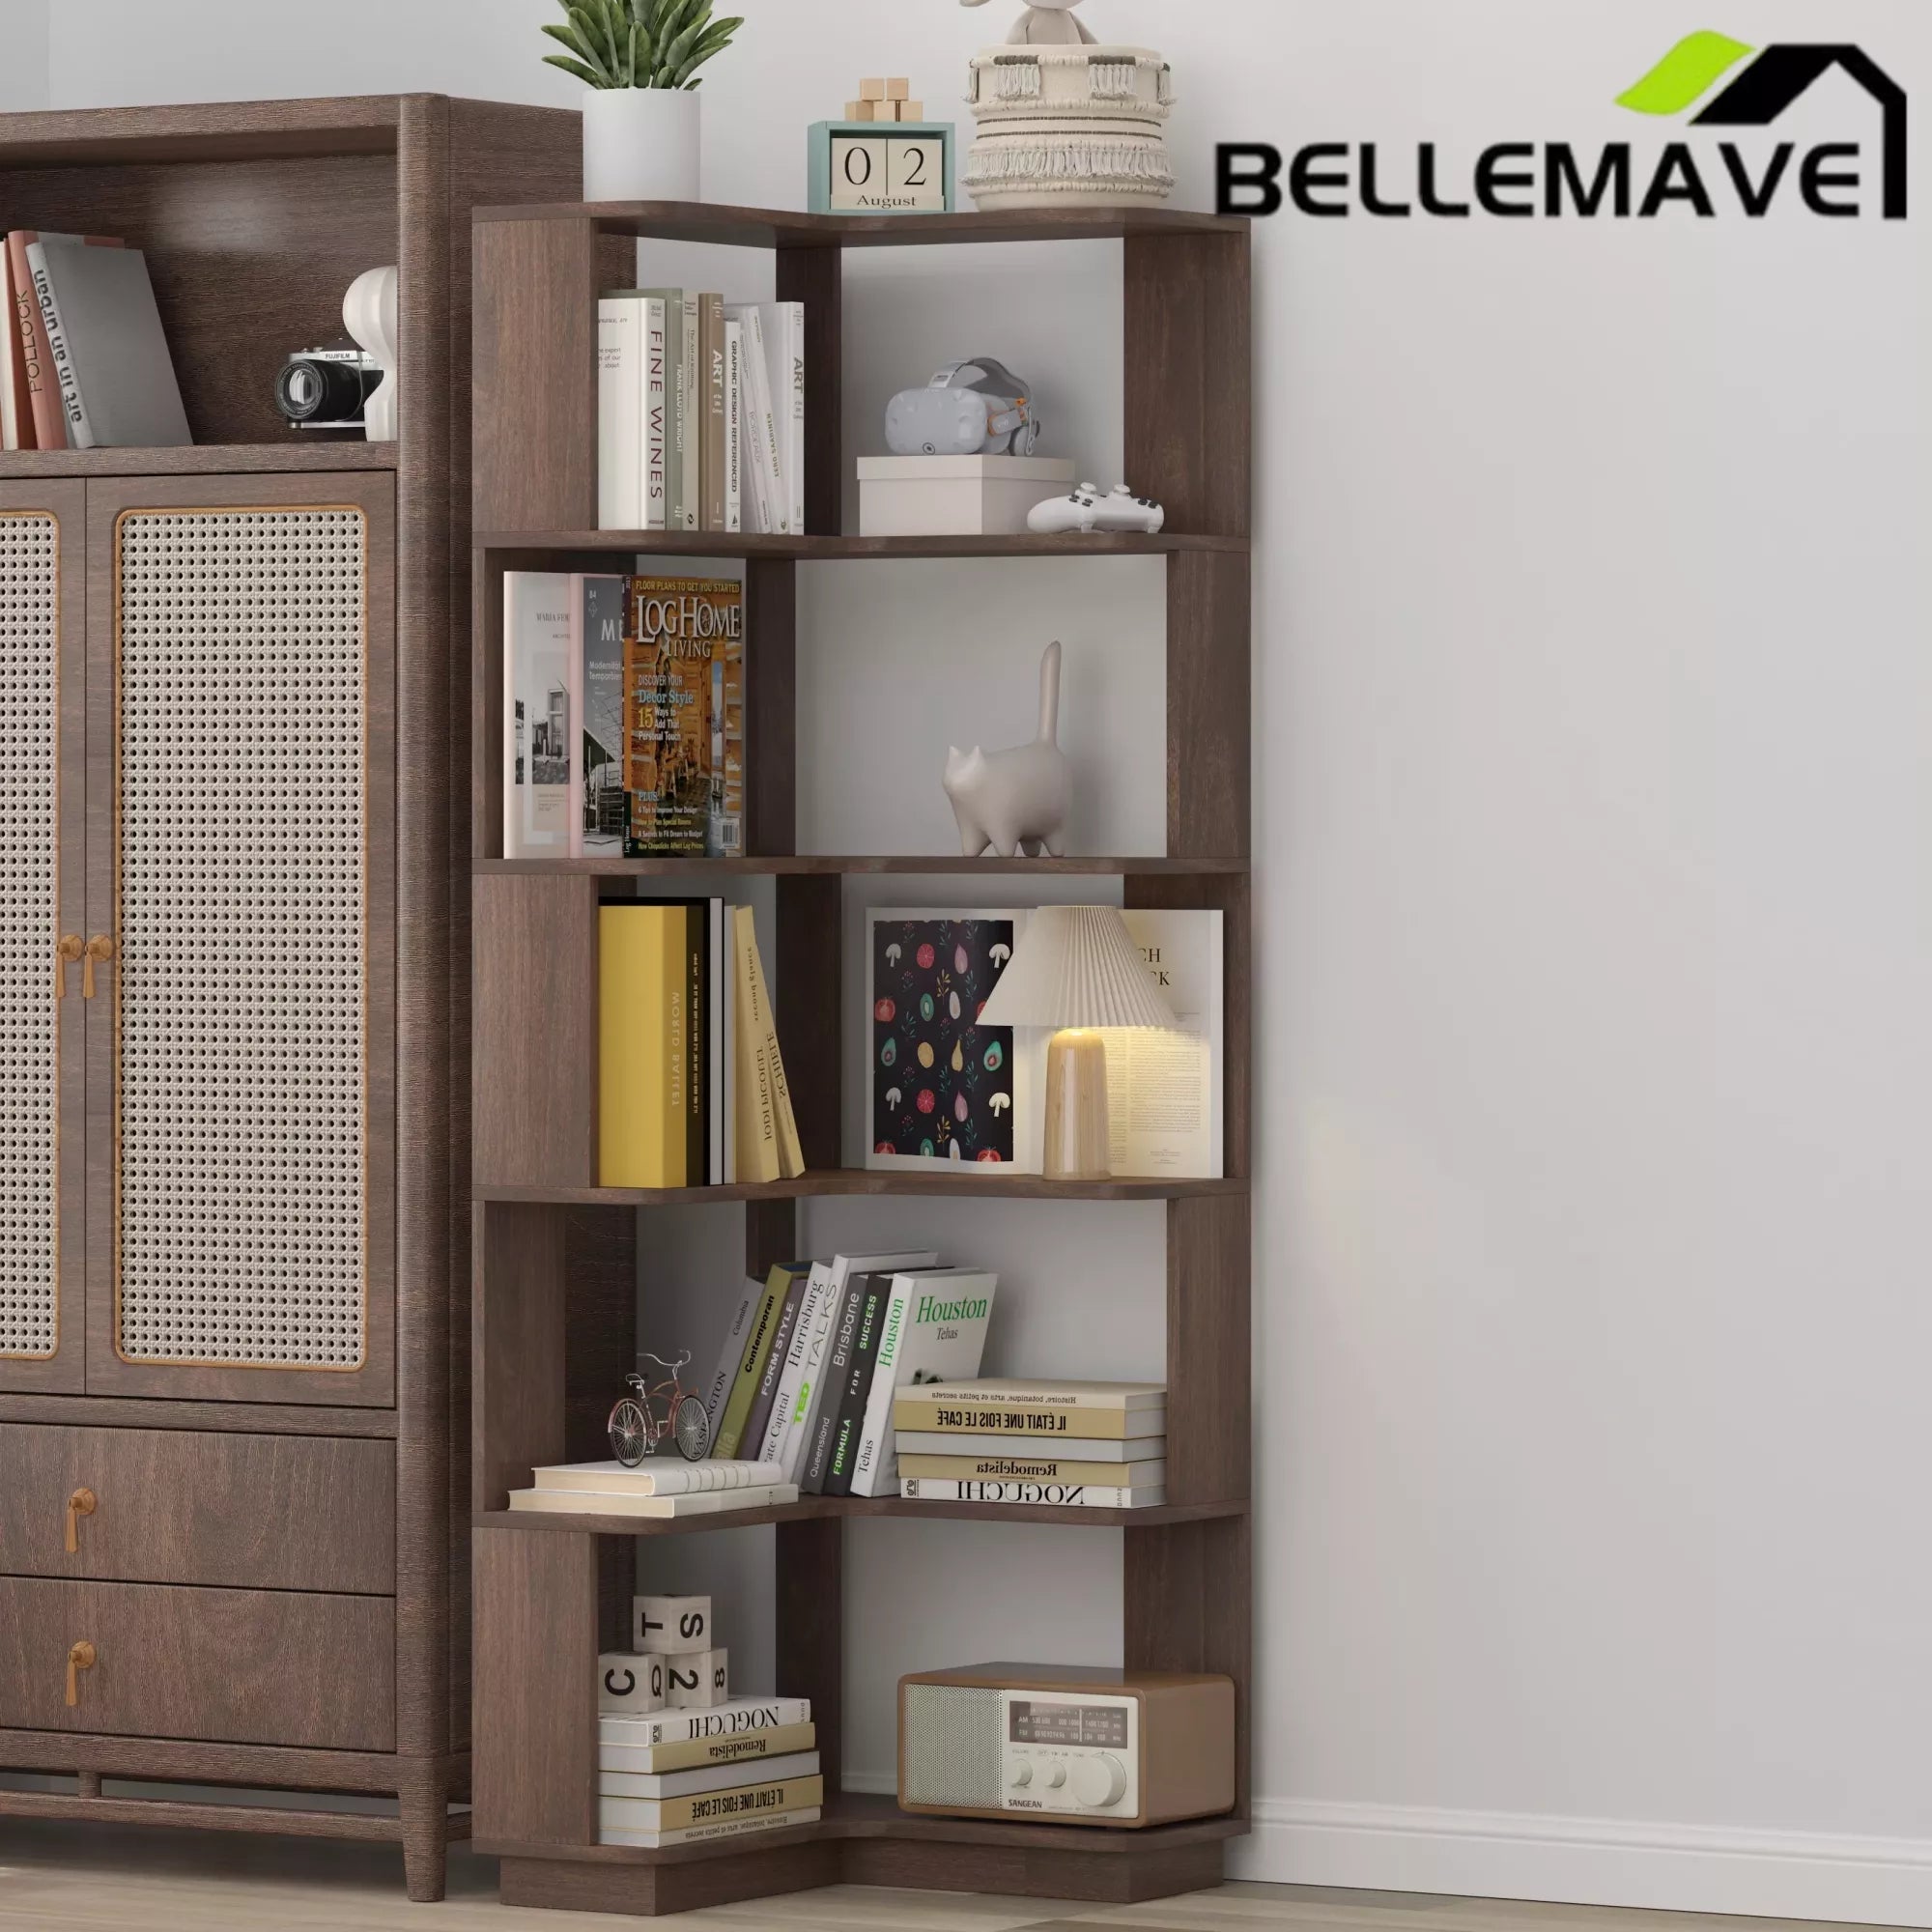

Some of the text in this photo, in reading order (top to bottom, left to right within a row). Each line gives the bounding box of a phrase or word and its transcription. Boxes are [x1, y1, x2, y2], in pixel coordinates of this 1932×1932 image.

[856, 194, 917, 210] August
[16, 290, 43, 393] POLLOCK
[34, 269, 83, 423] art in an urban
[650, 329, 663, 392] FINE
[712, 349, 724, 387] ART
[793, 356, 804, 394] ART
[650, 406, 663, 498] WINES
[636, 580, 740, 593] FLOOR PLANS TO GET YOU STARTED
[667, 639, 711, 658] LIVING
[639, 674, 683, 686] DISCOVER YOUR
[654, 706, 669, 718] Ways
[668, 689, 694, 708] Style
[638, 707, 654, 728] 15
[654, 719, 666, 728] Add
[638, 731, 681, 741] Personal Touch
[787, 1280, 824, 1369] Harrisburg
[917, 1295, 988, 1323] Houston
[745, 1294, 775, 1374] Contemporan
[833, 1292, 861, 1368] Brisbane
[878, 1297, 904, 1368] Houston
[760, 1301, 795, 1397] FORM STYLE
[793, 1283, 838, 1427] TED TALKS
[833, 1294, 877, 1475] FORMULA FOR SUCCESS
[770, 1392, 791, 1439] Capital
[810, 1415, 831, 1479] Queensland
[641, 1611, 664, 1638] T
[679, 1612, 704, 1639] S
[604, 1668, 636, 1696] C
[651, 1663, 662, 1697] Q
[668, 1667, 699, 1691] 2
[687, 1706, 780, 1739] NOGUCHI
[709, 1738, 766, 1759] Remodelista
[691, 1788, 784, 1823] IL ÉTAIT UNE FOIS LE CAFÉ
[1008, 1799, 1043, 1809] SANGEAN
